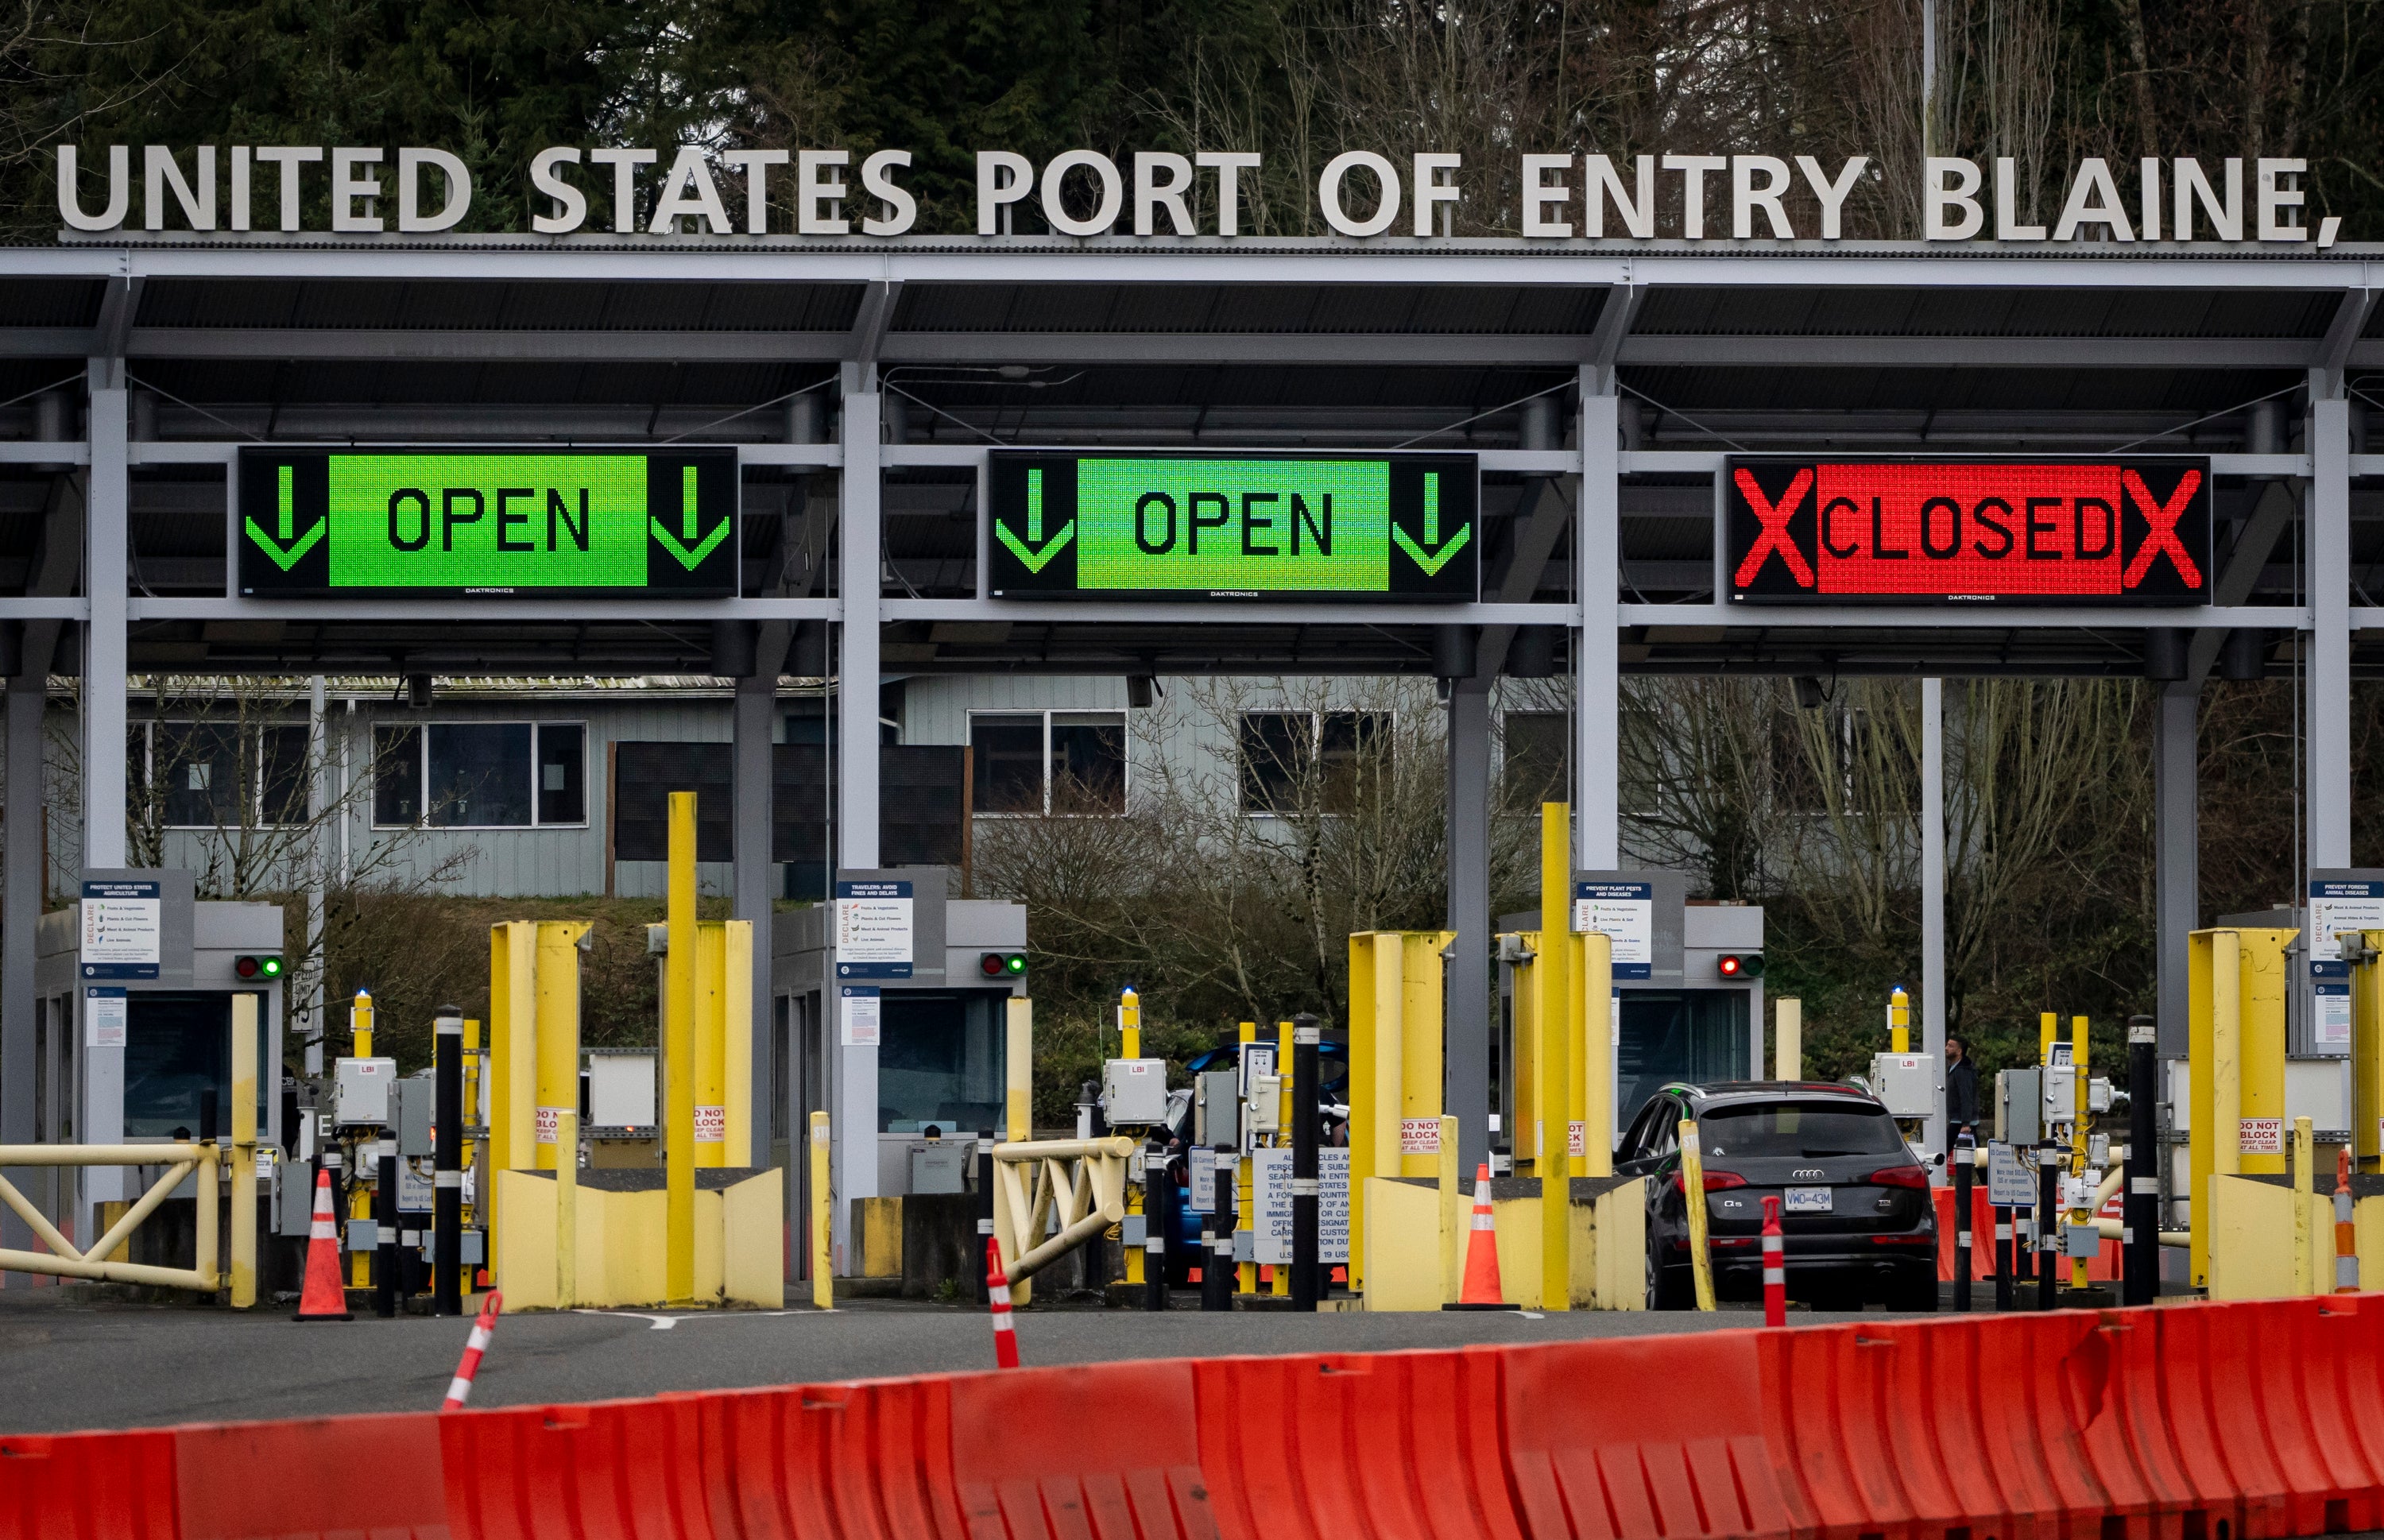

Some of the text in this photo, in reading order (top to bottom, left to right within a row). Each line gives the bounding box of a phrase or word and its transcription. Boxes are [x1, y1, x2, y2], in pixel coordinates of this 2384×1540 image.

[57, 145, 2342, 248] UNITED STATES PORT OF ENTRY BLAINE,
[388, 488, 589, 552] OPEN
[1135, 492, 1333, 557] OPEN
[1821, 497, 2115, 560] CLOSED
[294, 971, 313, 981] SPEED
[295, 985, 311, 994] LIMIT
[282, 1077, 295, 1085] CBP
